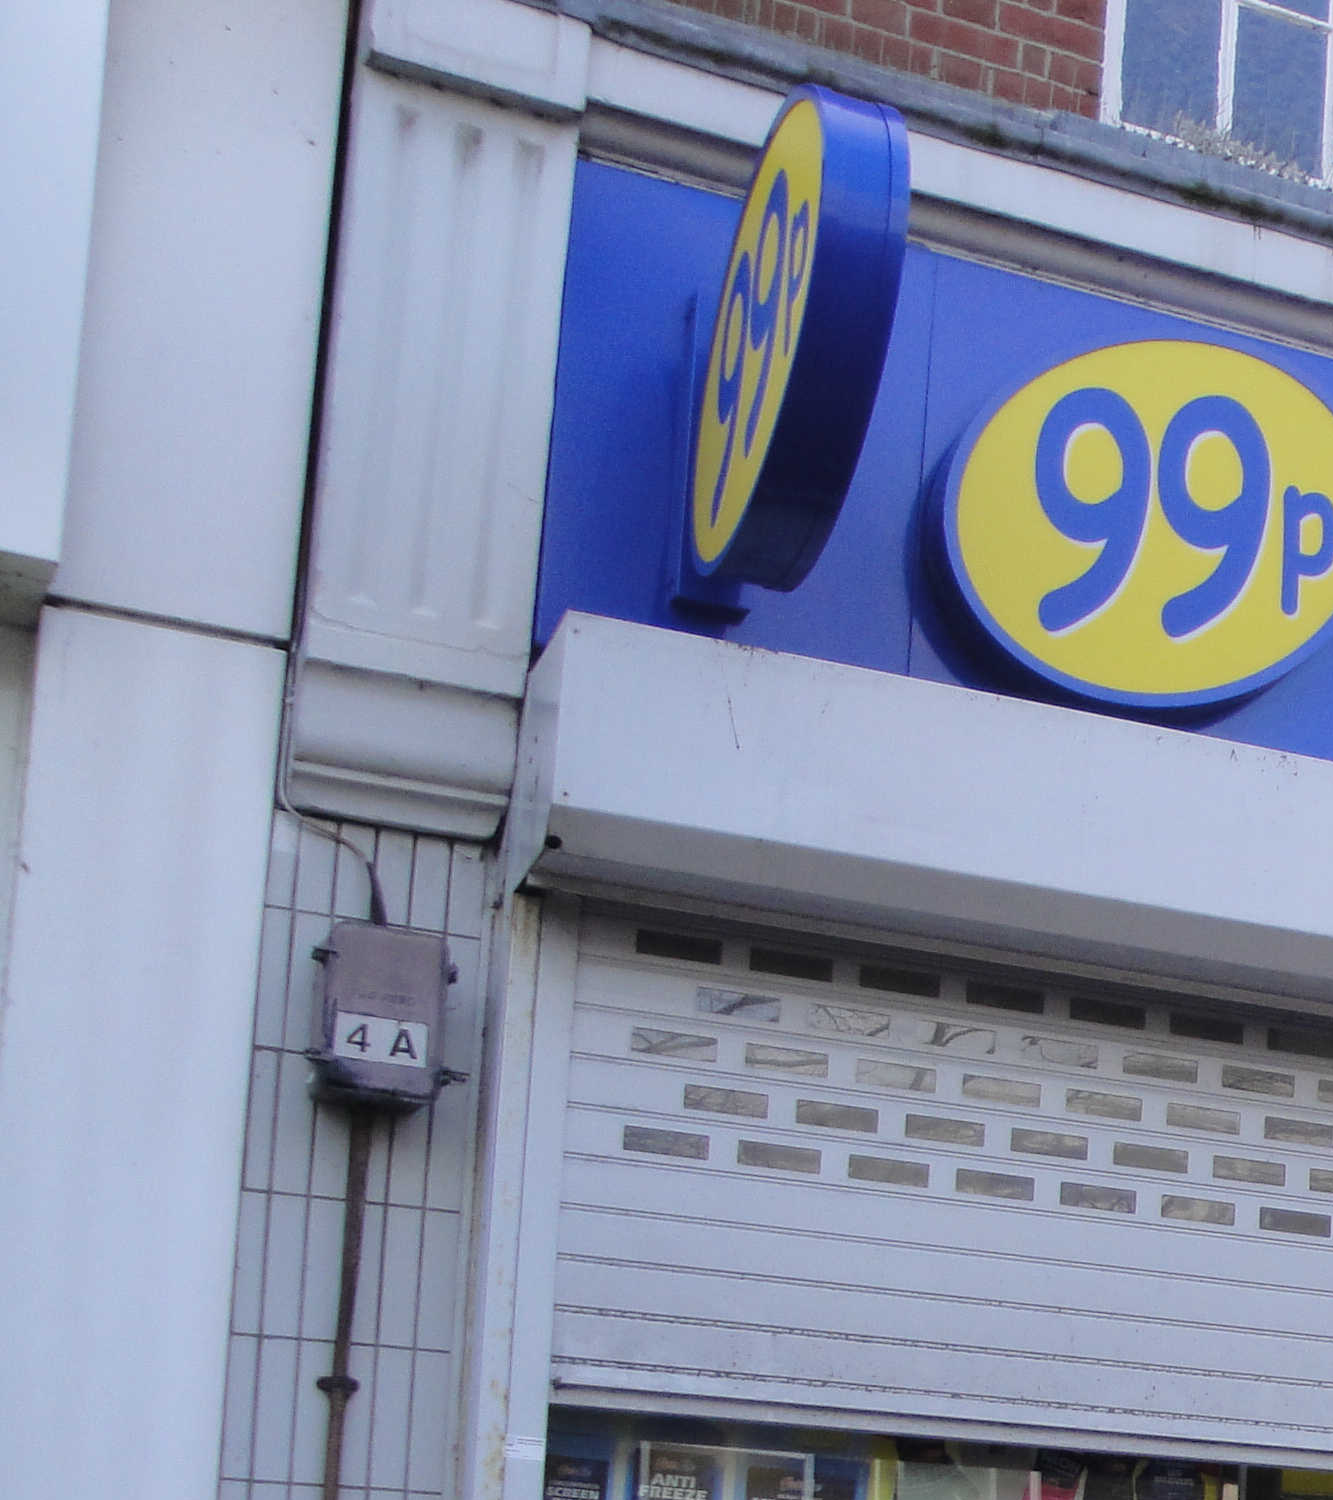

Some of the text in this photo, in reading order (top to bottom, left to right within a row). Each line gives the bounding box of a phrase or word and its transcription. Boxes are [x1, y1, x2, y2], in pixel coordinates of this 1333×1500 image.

[710, 168, 813, 532] 99p
[346, 1022, 419, 1060] 4 A
[546, 1485, 601, 1500] SCREEN
[652, 1472, 698, 1488] ANTI
